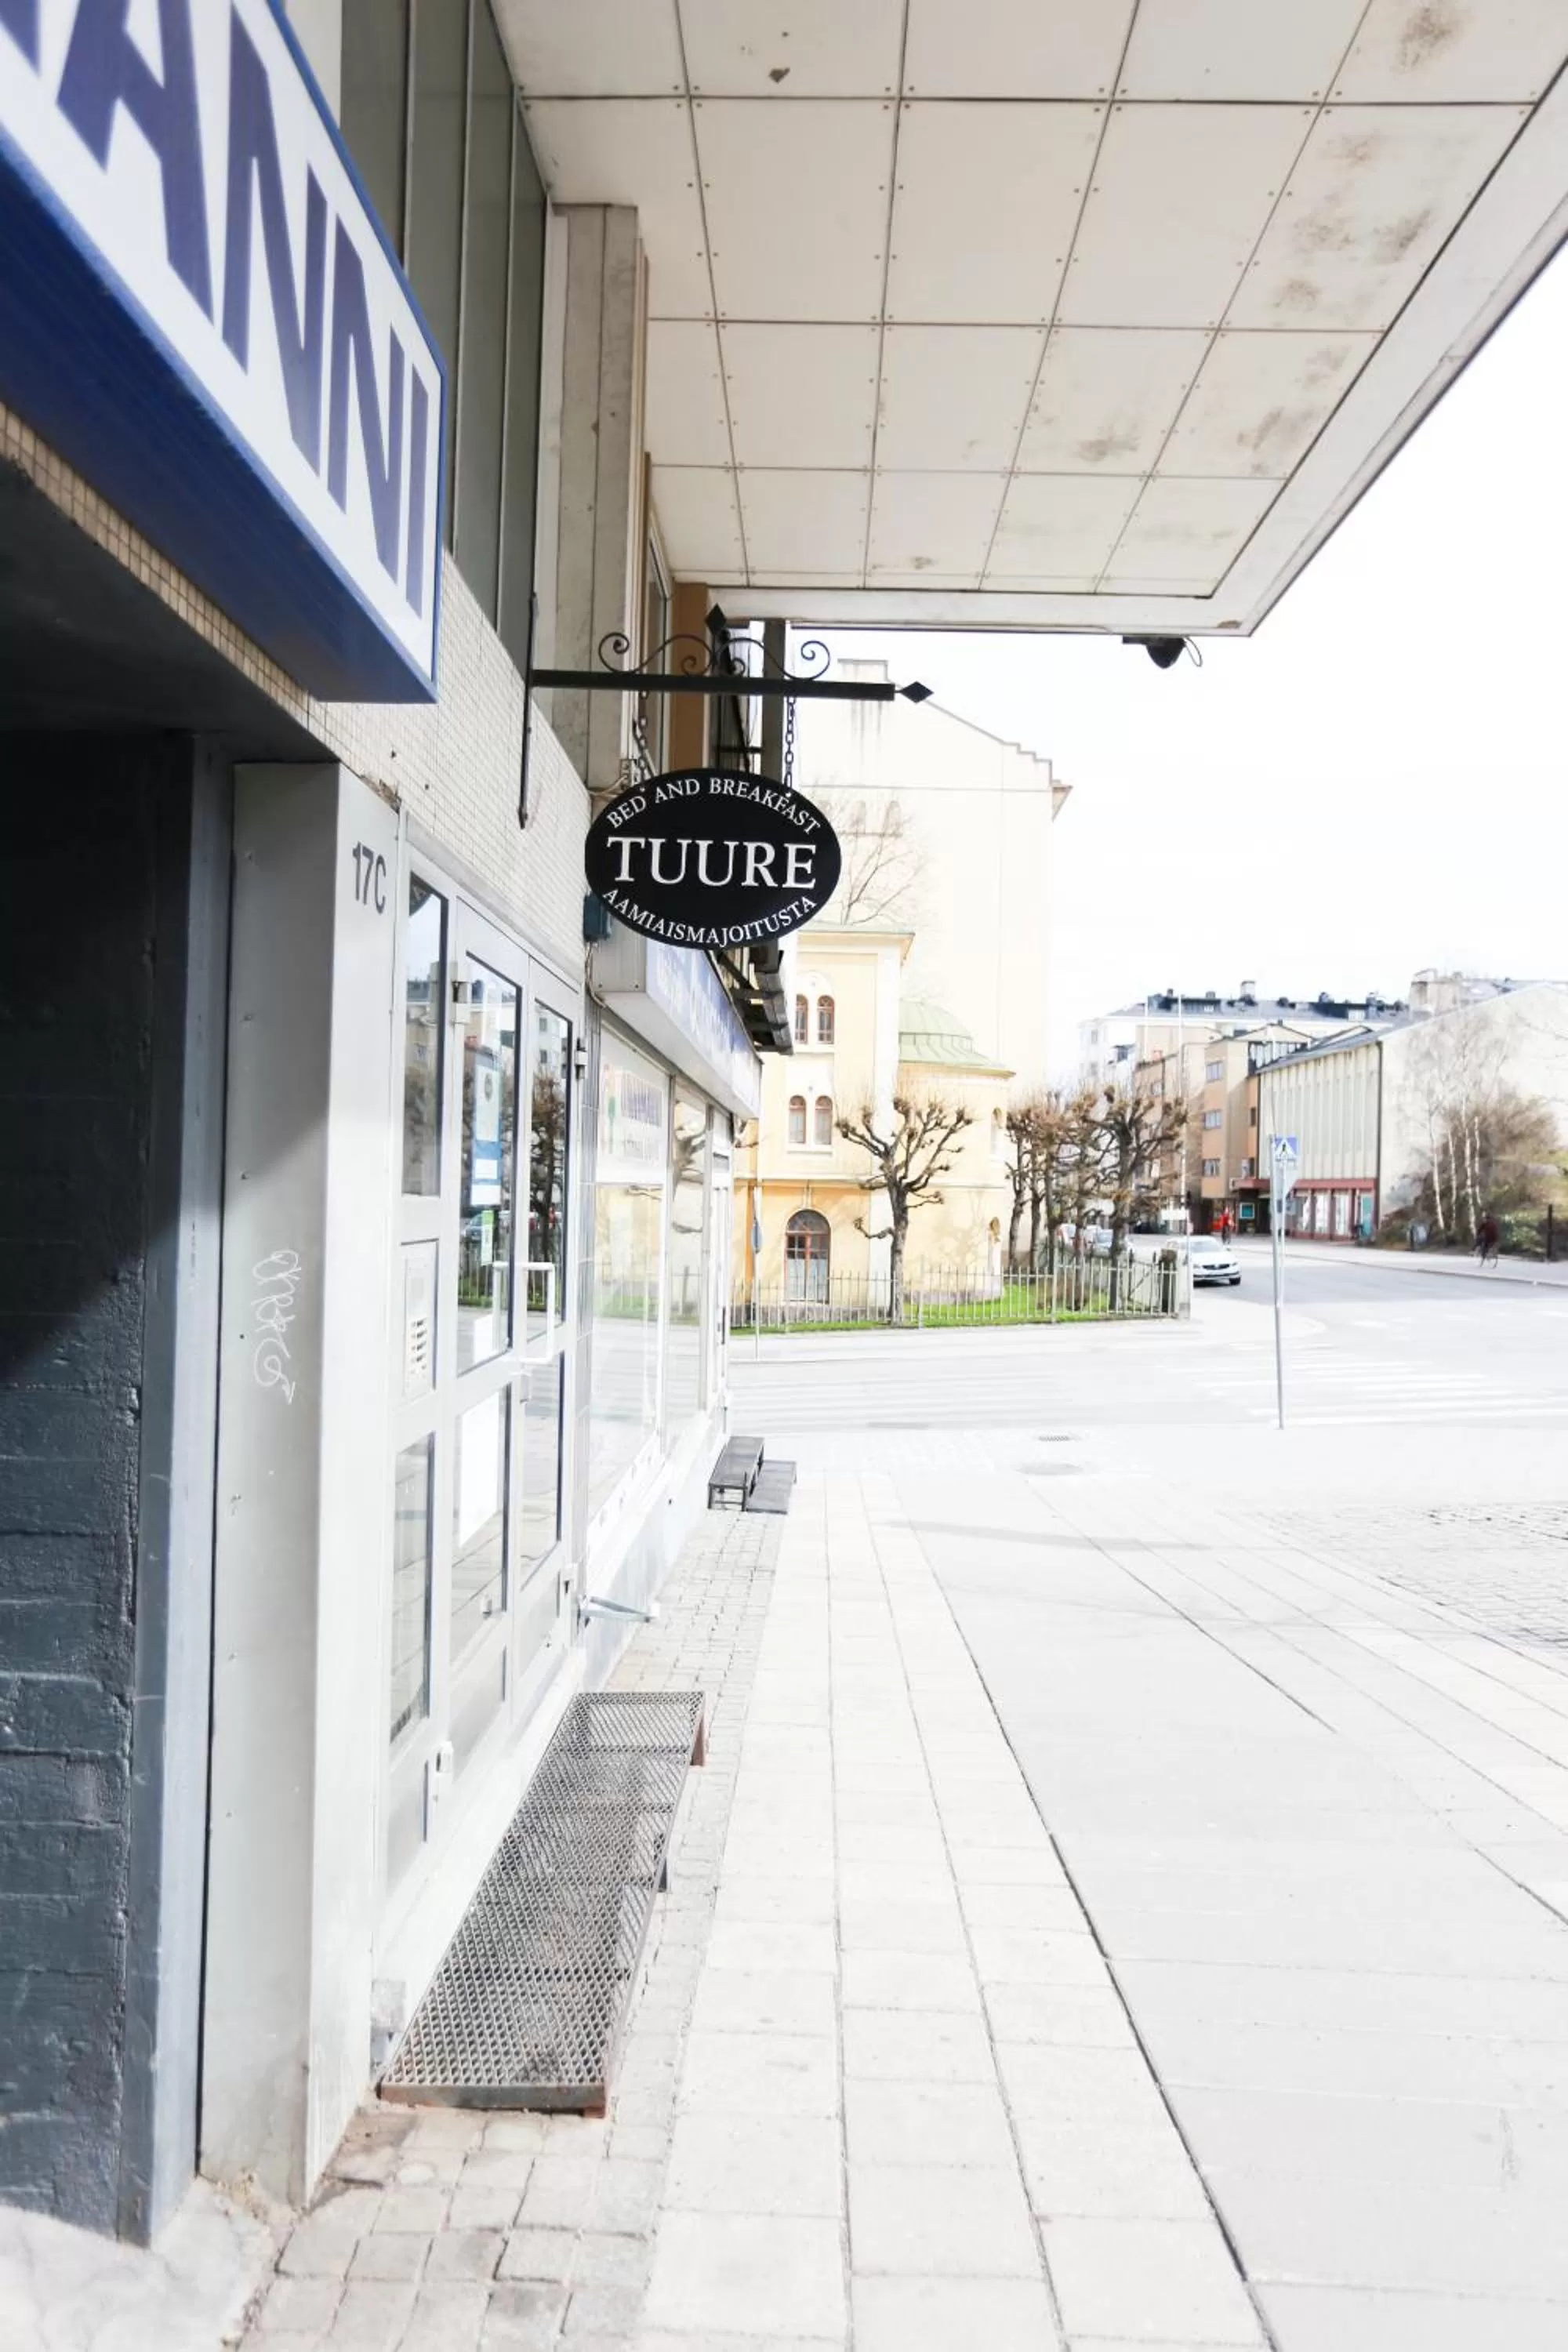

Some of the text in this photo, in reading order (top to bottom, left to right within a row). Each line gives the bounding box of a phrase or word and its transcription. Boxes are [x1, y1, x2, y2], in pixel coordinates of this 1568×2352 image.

[0, 0, 430, 620] ANNI
[607, 778, 821, 835] BED AND BREAKFAST
[353, 841, 387, 914] 17C
[606, 836, 817, 889] TUURE
[602, 889, 817, 948] AAMIAISMAJOITUSTA
